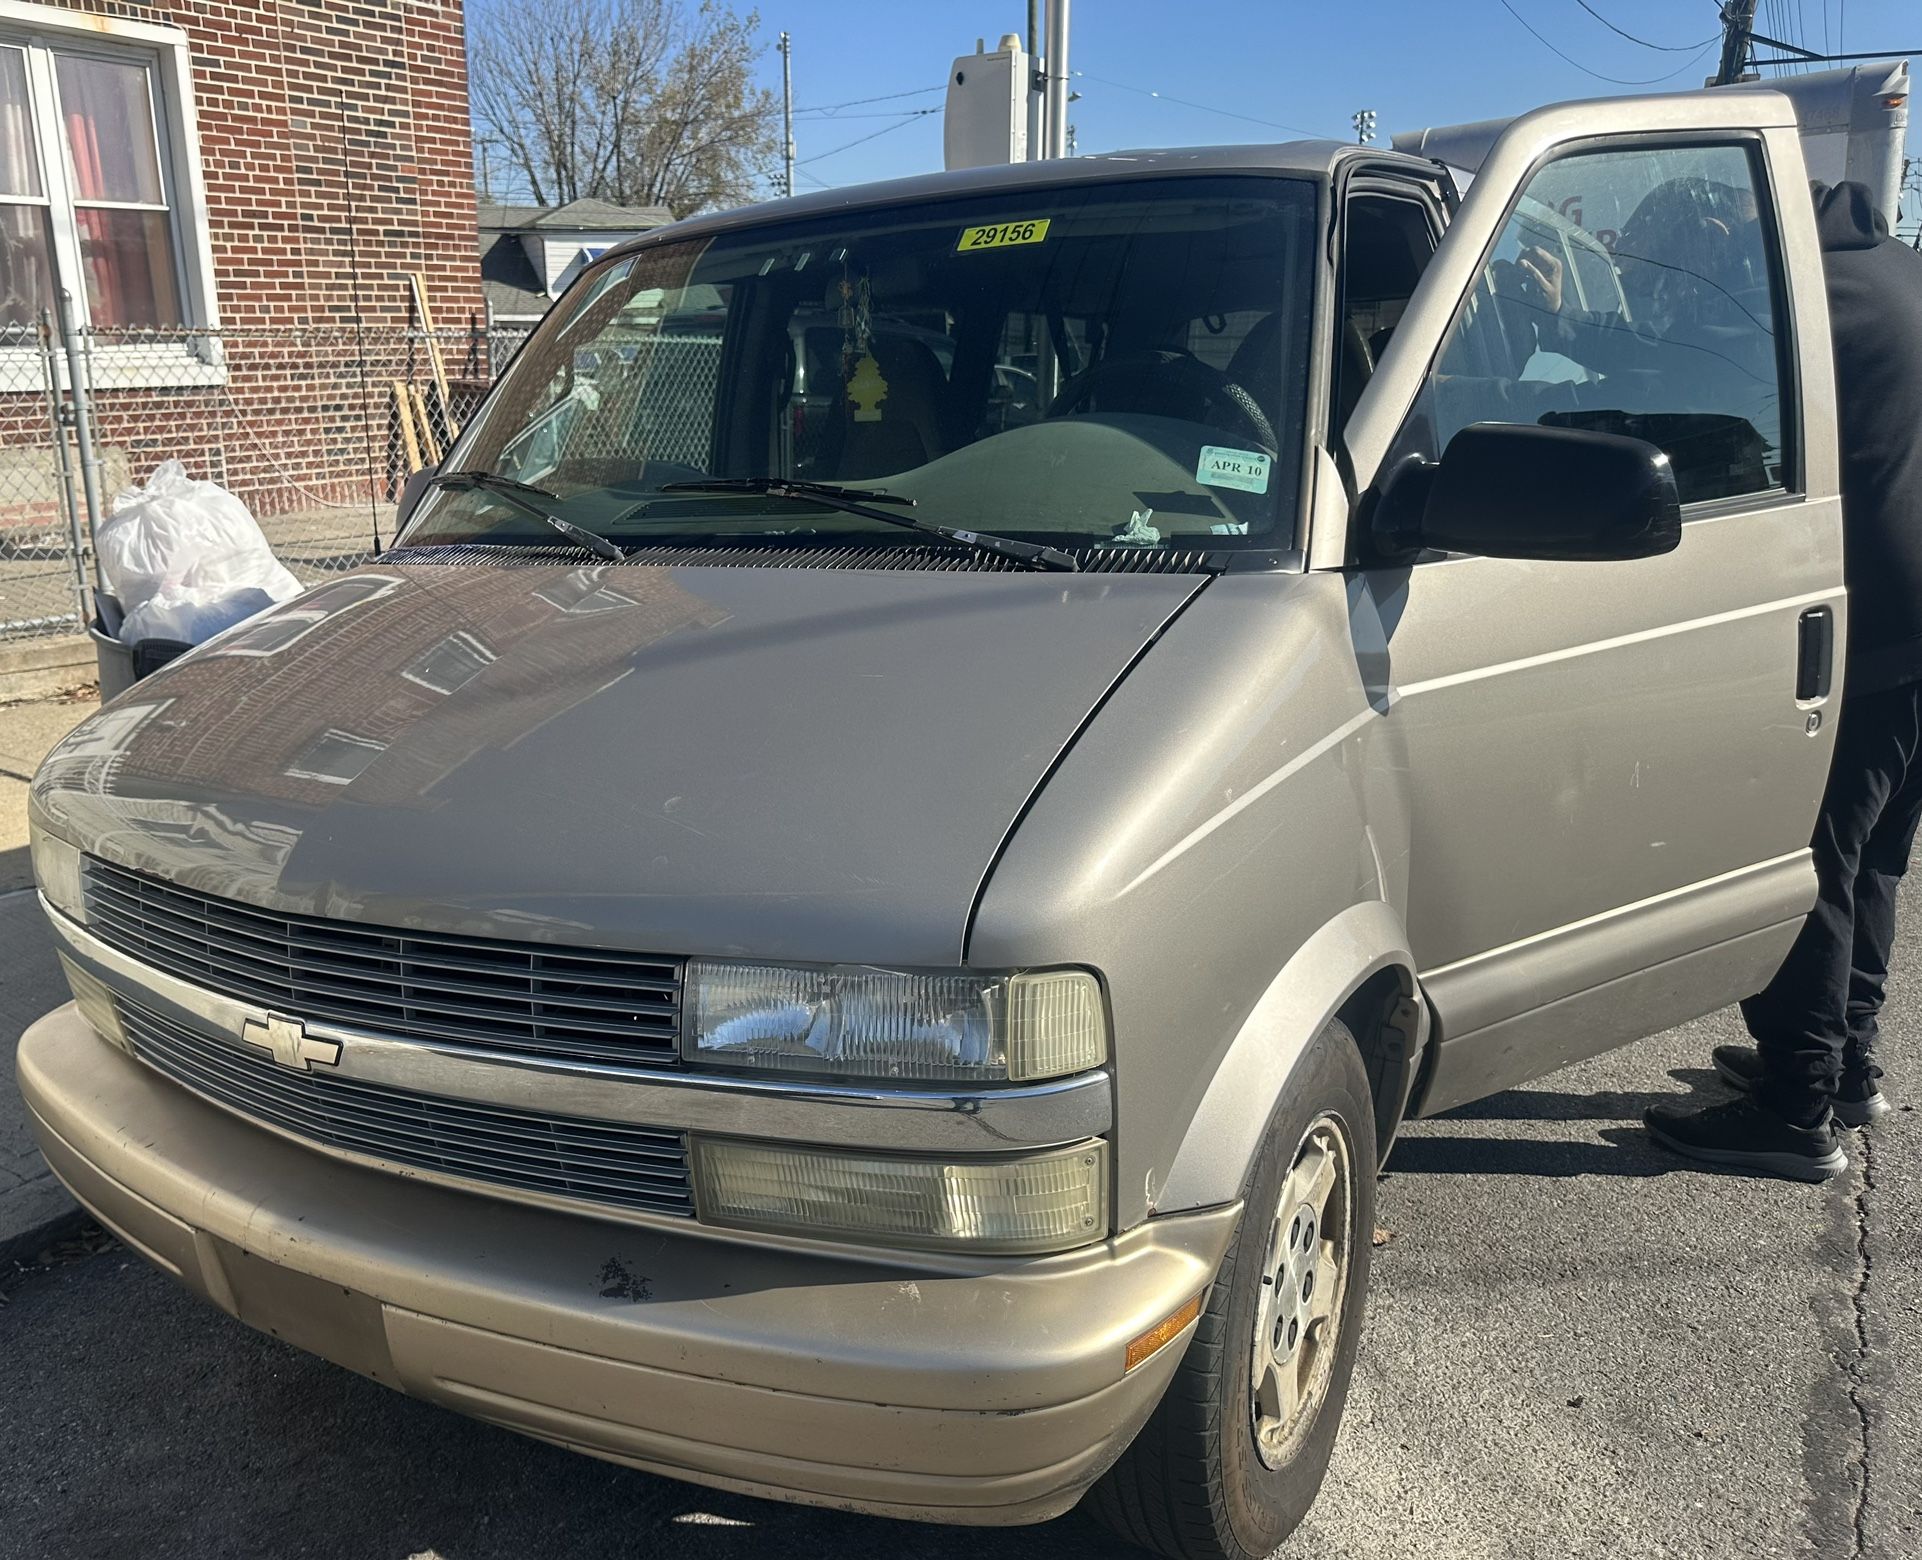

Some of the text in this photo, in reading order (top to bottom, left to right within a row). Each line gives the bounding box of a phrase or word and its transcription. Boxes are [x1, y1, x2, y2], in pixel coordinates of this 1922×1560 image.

[970, 223, 1036, 246] 29156
[1211, 460, 1262, 477] APR 10
